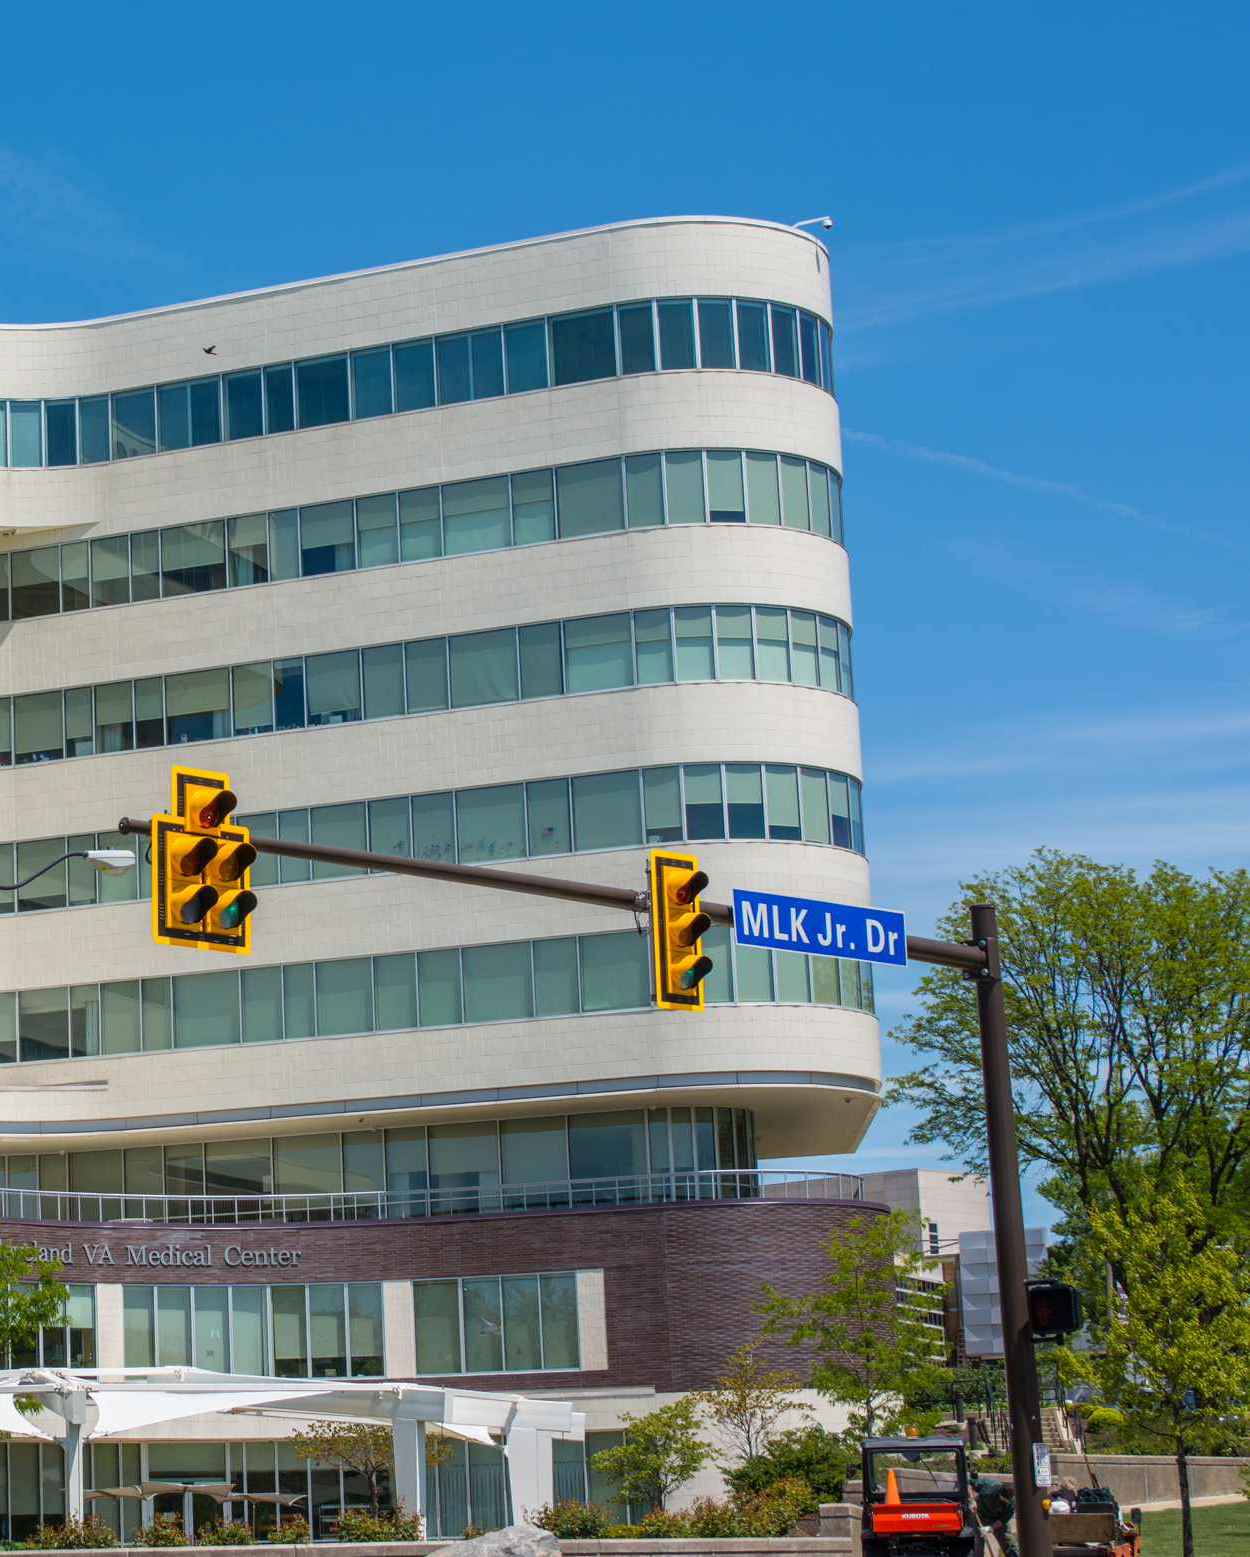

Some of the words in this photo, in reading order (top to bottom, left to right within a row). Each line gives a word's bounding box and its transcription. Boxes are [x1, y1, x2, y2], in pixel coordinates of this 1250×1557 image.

[741, 900, 810, 944] MLK
[817, 912, 855, 950] Jr.
[865, 918, 898, 956] Dr
[82, 1244, 115, 1265] VA
[125, 1244, 213, 1266] Medical
[224, 1245, 301, 1267] Center
